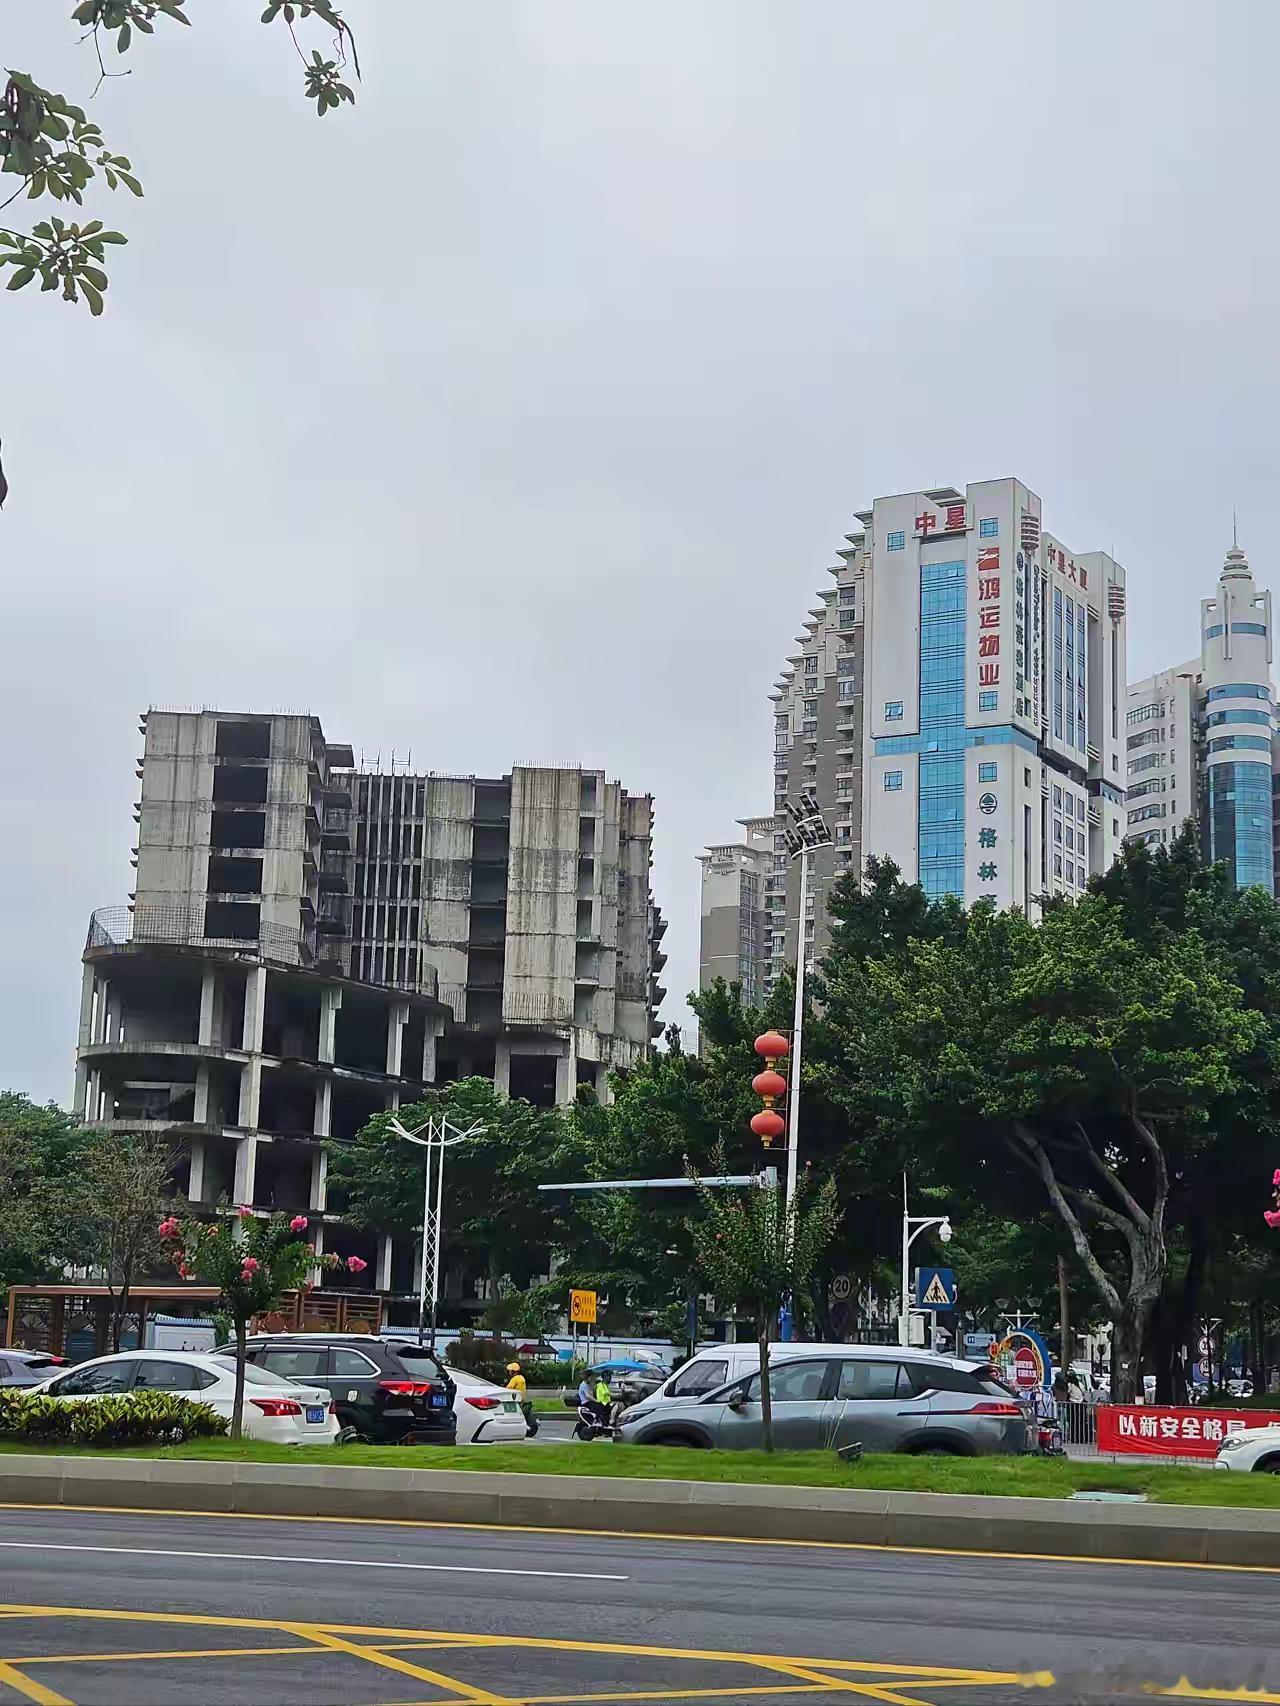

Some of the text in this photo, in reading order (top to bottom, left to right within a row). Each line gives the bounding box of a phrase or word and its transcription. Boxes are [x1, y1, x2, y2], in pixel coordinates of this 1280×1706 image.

[915, 506, 966, 536] 中星
[1047, 543, 1088, 590] 中星大厦
[978, 577, 1000, 687] 鸿运物业
[835, 1280, 849, 1292] 20
